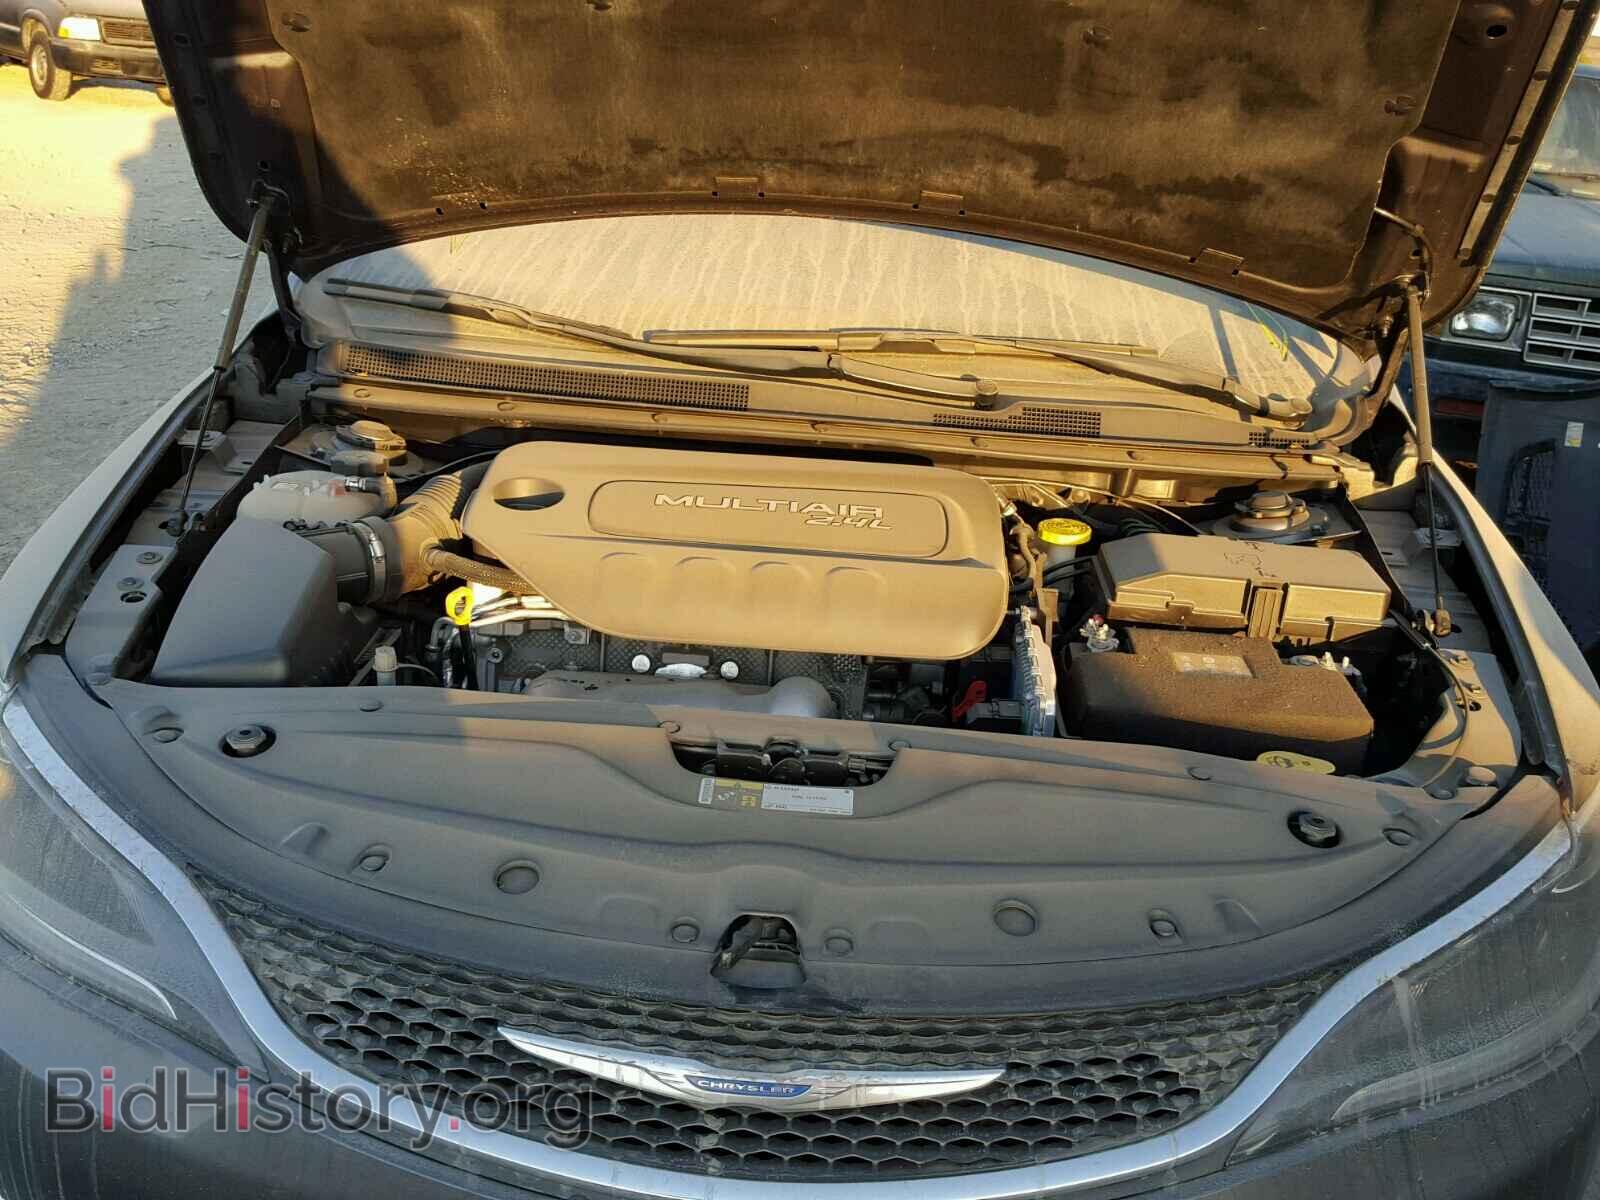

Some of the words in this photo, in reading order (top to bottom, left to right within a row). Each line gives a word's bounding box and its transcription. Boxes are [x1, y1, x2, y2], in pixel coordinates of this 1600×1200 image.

[654, 493, 884, 518] MULTIAIR
[804, 515, 893, 531] 2.4L
[697, 1080, 794, 1094] CHRYSLER
